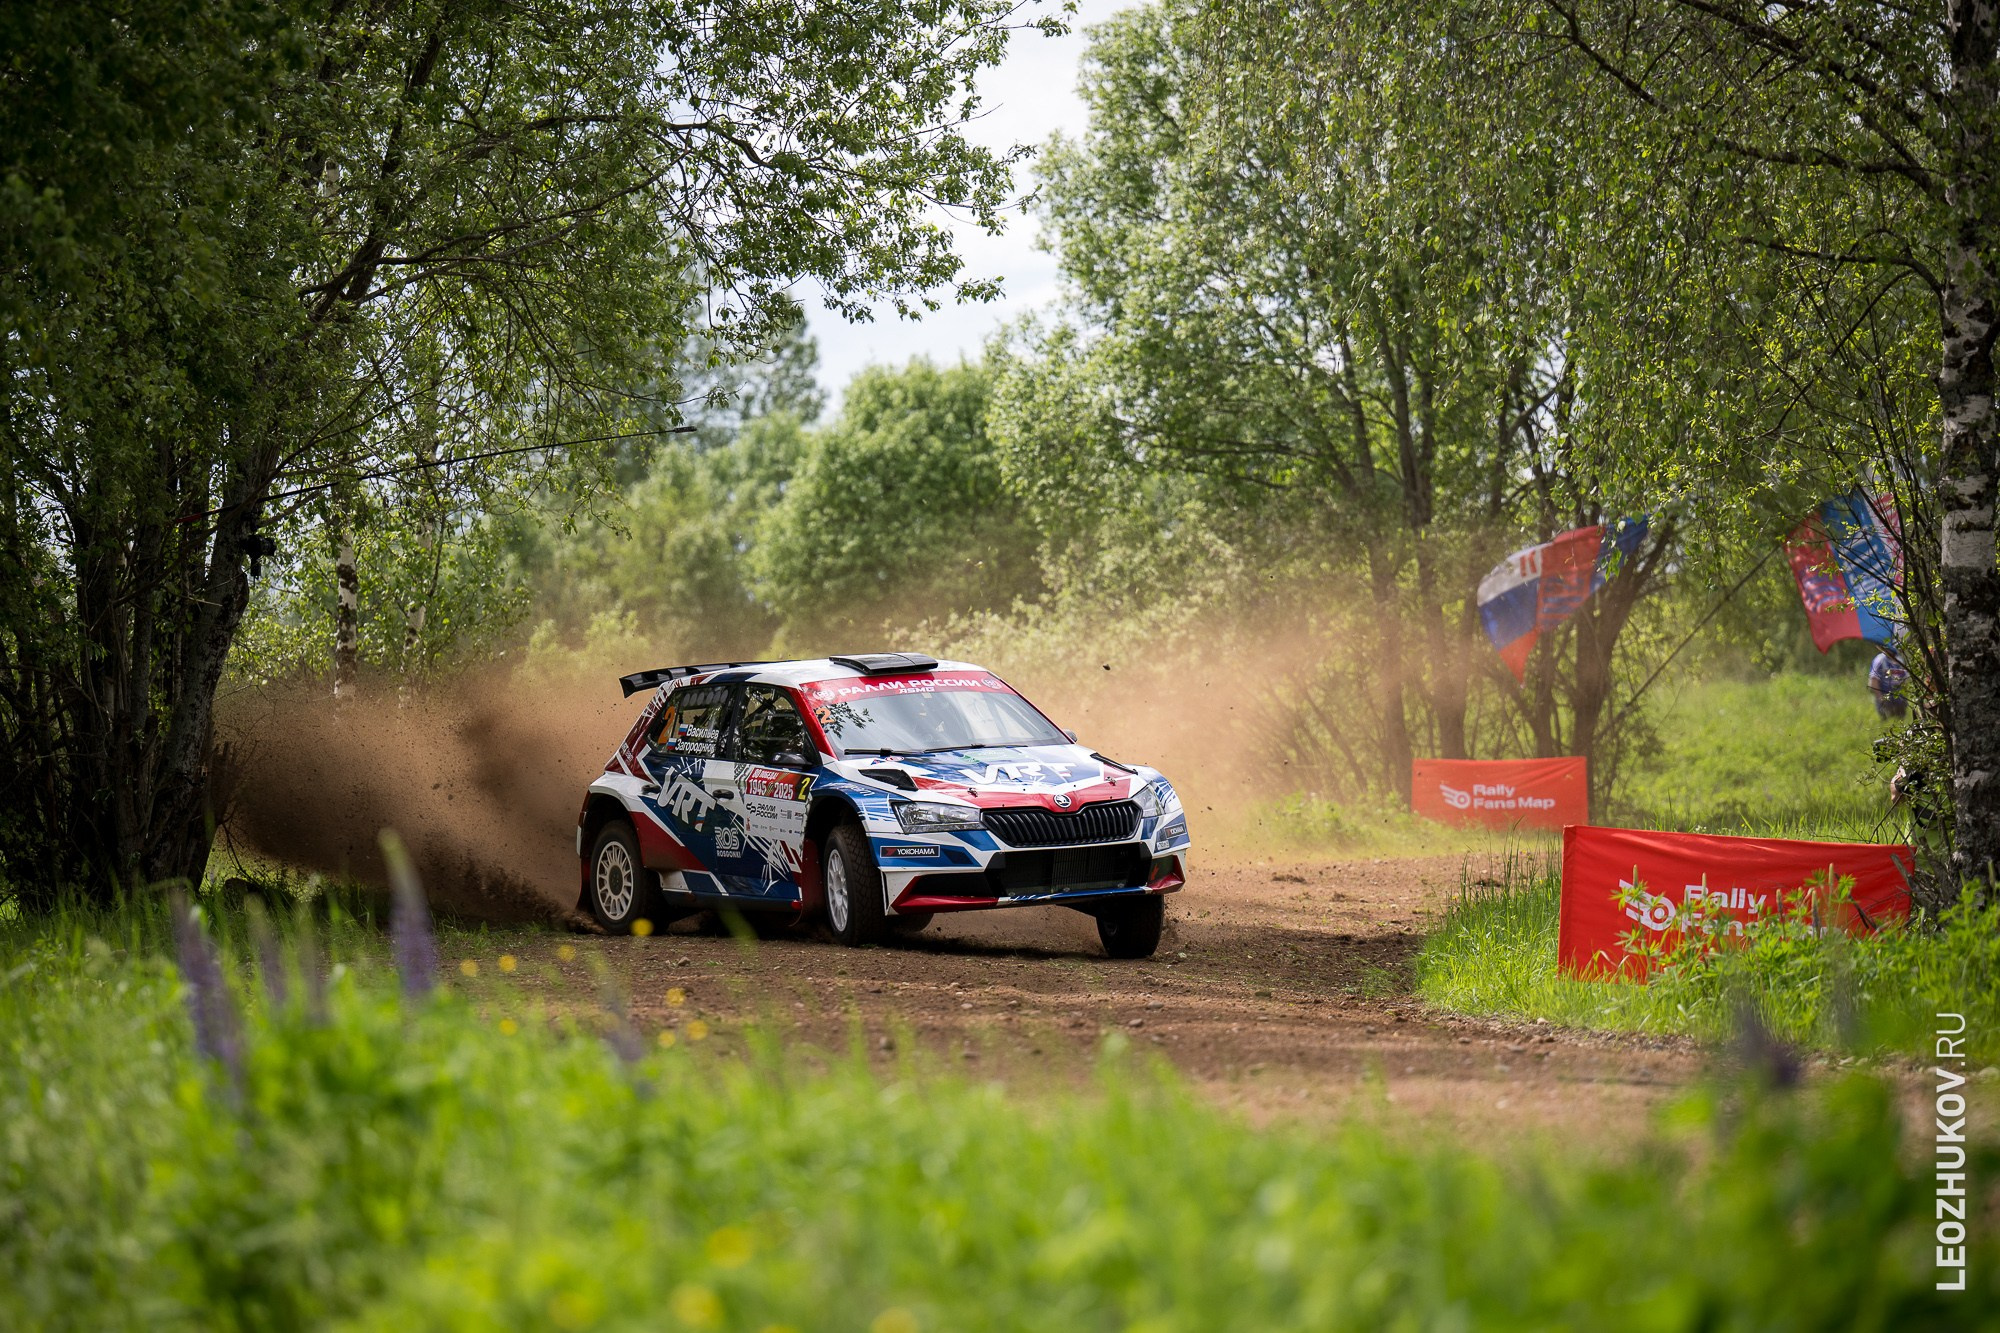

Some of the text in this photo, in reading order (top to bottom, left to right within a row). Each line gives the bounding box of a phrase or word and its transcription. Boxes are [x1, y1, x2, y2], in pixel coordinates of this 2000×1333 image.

[839, 680, 904, 697] РАЛЛИ
[907, 678, 981, 687] РОССИИ
[657, 705, 677, 745] 2
[815, 707, 836, 724] 2
[686, 725, 720, 740] Васильев
[957, 762, 1077, 785] VRT
[748, 778, 794, 800] 1945 2025
[797, 777, 811, 800] 2
[1472, 784, 1516, 797] Rally
[657, 765, 717, 833] VRT
[1473, 797, 1556, 810] Fans Map
[755, 811, 778, 820] РОССИИ
[714, 826, 740, 850] ROS
[896, 847, 936, 856] YOKOHAMA
